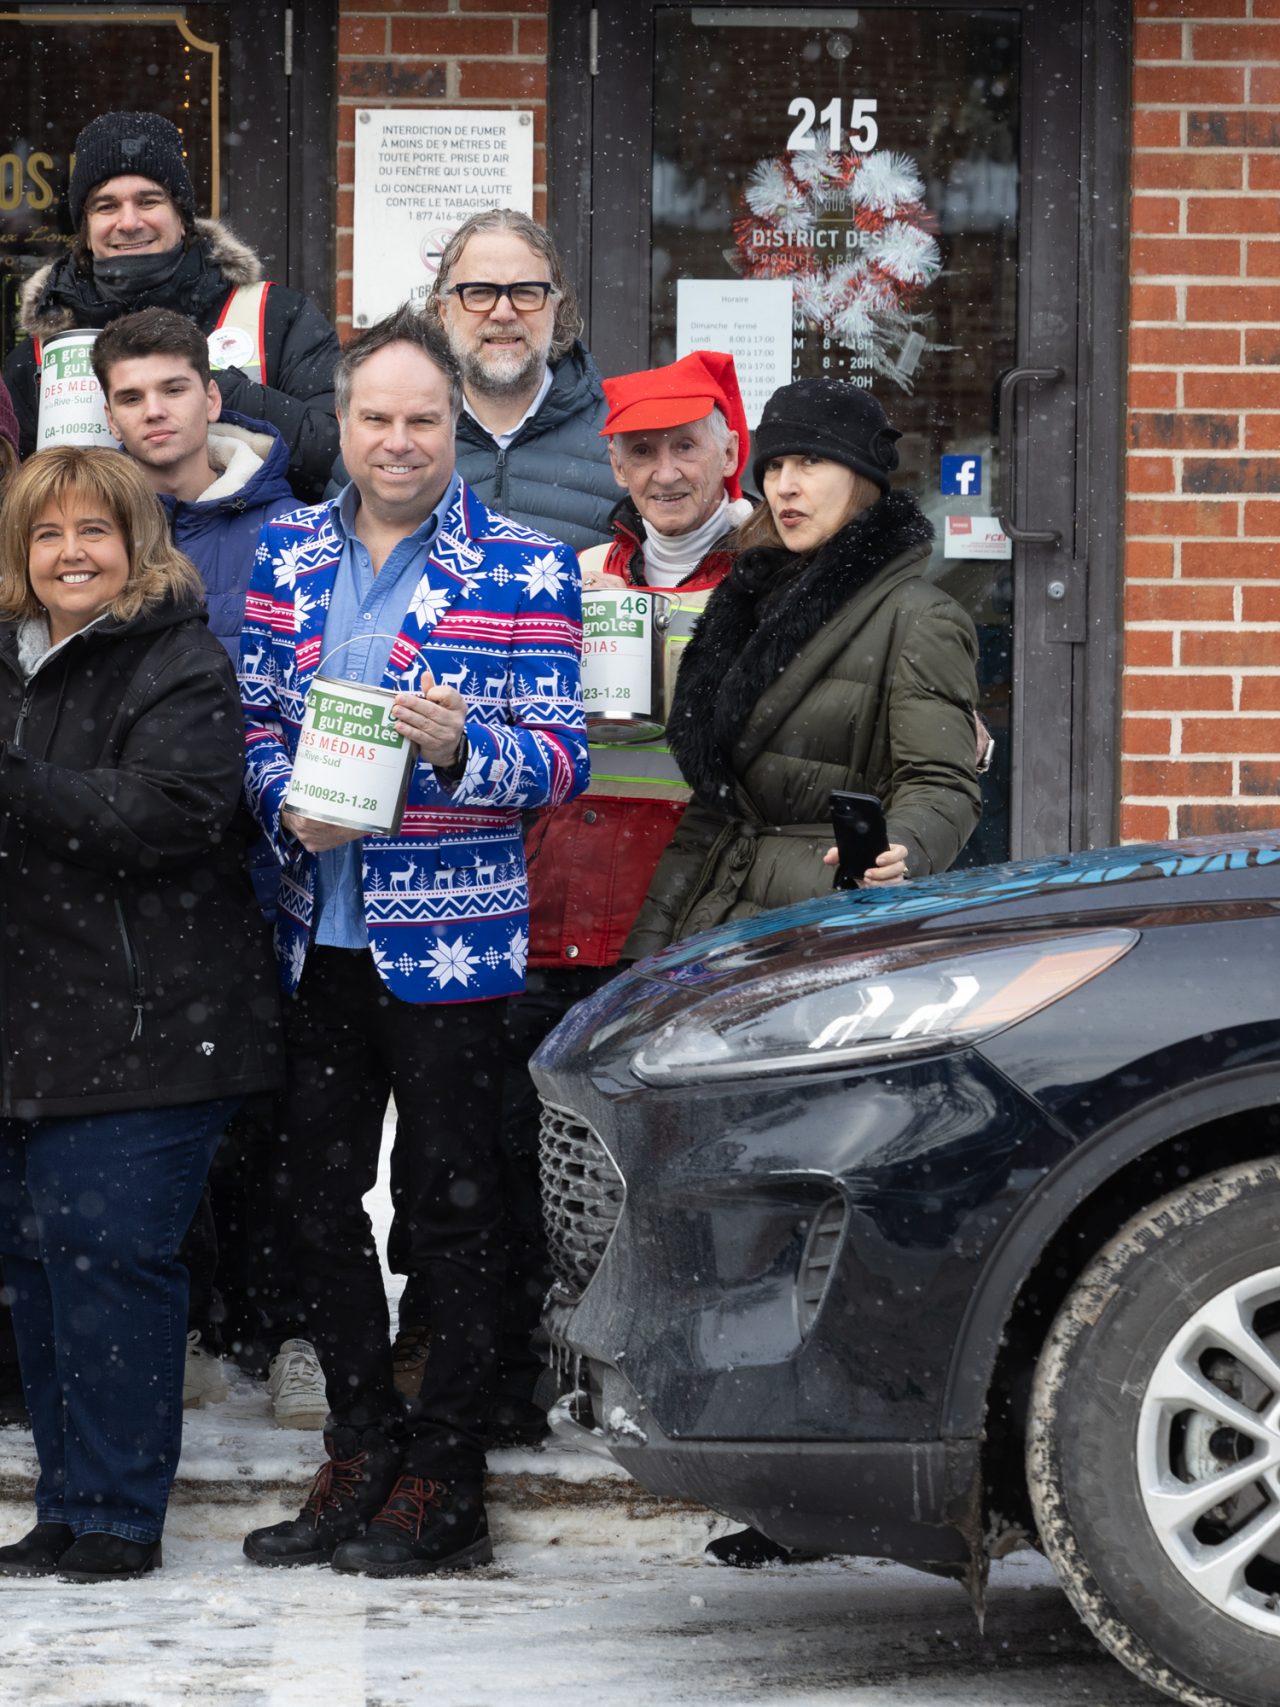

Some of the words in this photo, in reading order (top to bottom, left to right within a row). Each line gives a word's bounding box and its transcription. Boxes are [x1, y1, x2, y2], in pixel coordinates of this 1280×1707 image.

[382, 125, 452, 136] INTERDICTION
[455, 126, 468, 136] DE
[471, 126, 506, 136] FUMER
[786, 97, 878, 152] 215
[391, 139, 424, 149] MOINS
[426, 140, 440, 149] DE
[442, 140, 448, 149] 9
[494, 140, 508, 150] DE
[378, 153, 411, 162] TOUTE
[451, 153, 480, 163] PRISE
[379, 166, 393, 176] OU
[395, 164, 441, 176] FENÊTRE
[444, 166, 461, 177] QUI
[374, 184, 391, 194] LOI
[394, 184, 462, 194] CONCERNANT
[465, 185, 479, 195] LA
[481, 185, 512, 194] LUTTE
[386, 197, 426, 207] CONTRE
[429, 198, 441, 207] LE
[444, 198, 501, 208] TABAGISME
[416, 212, 433, 221] 877
[721, 295, 749, 304] Horaire
[690, 322, 728, 330] Dimanche
[793, 319, 805, 331] M
[823, 319, 831, 331] 8
[690, 336, 711, 344] Lundi
[754, 336, 775, 344] 17:00
[793, 337, 804, 349] M
[823, 337, 831, 350] 8
[754, 349, 775, 357] 17:00
[45, 353, 57, 367] La
[792, 356, 800, 368] J
[822, 356, 830, 369] 8
[850, 356, 873, 369] 20H
[45, 382, 63, 399] DES
[620, 596, 648, 615] 46
[583, 640, 618, 654] DIAS
[320, 697, 374, 720] grande
[319, 735, 377, 761] MÉDIAS
[292, 779, 378, 811] CA-100923-1.28
